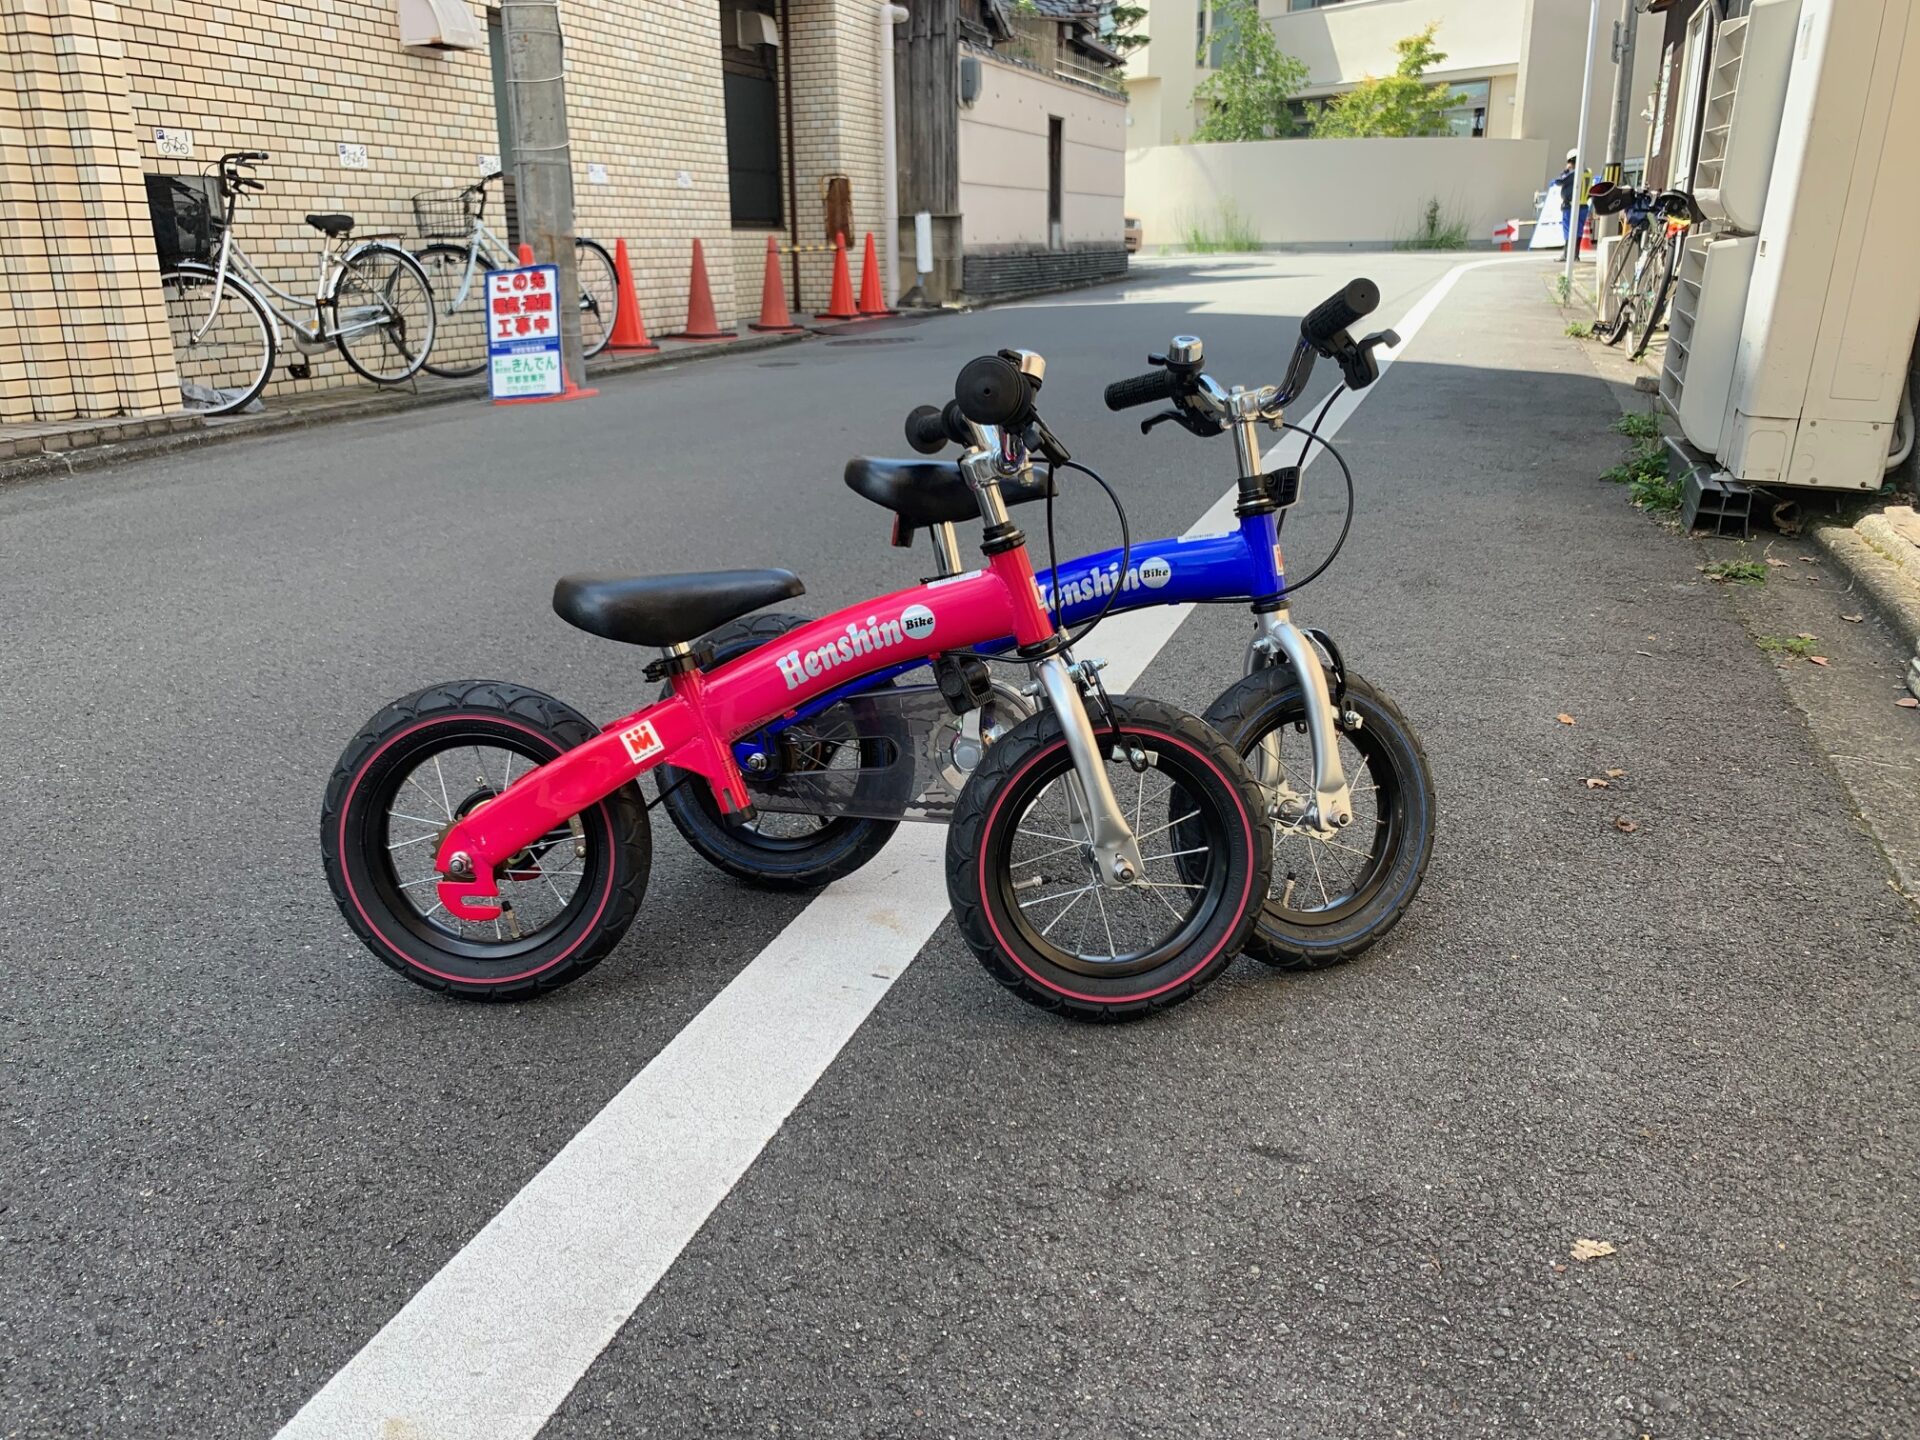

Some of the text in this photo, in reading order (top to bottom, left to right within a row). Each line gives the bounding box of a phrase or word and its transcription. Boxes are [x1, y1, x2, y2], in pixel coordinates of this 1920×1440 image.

[496, 271, 546, 293] この先
[512, 357, 557, 373] きんでん
[1143, 568, 1169, 579] Bike
[776, 615, 934, 690] Henshin Bike
